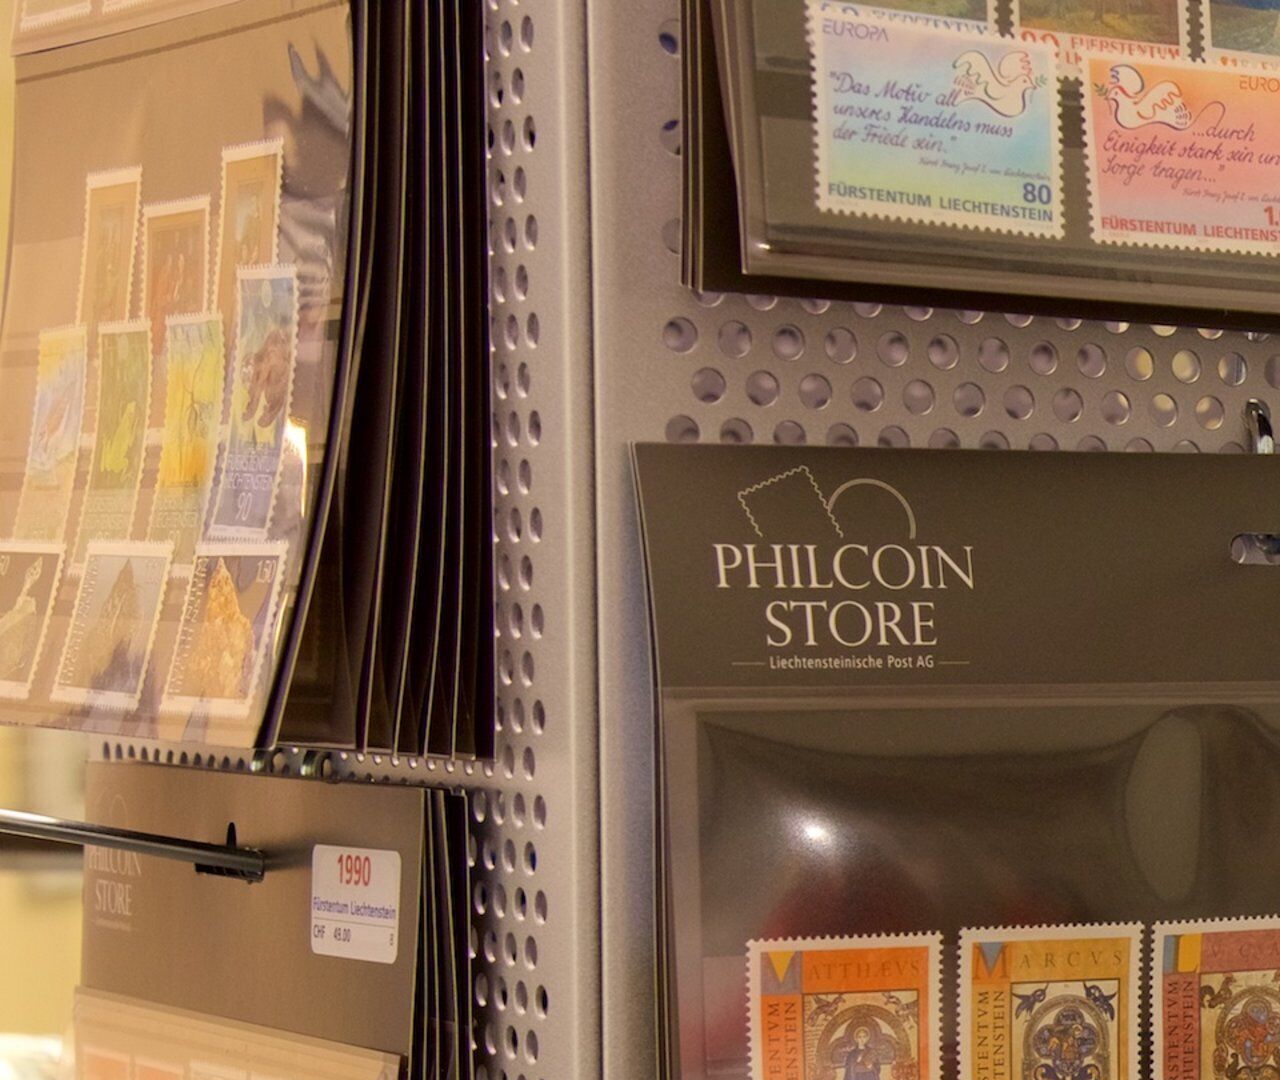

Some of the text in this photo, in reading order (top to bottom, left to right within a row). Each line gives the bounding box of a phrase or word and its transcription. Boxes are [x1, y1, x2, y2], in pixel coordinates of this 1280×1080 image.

[822, 19, 889, 43] EUROPA
[874, 80, 932, 104] Motiv
[935, 89, 959, 108] all
[832, 121, 909, 149] der Friede
[833, 104, 1013, 138] unseres Handelns muss
[1103, 130, 1174, 163] Einigkeit
[1178, 146, 1222, 162] stark
[828, 181, 1053, 222] FÜRSTENTUM LIECHTENSTEIN
[1022, 182, 1052, 205] 80
[1101, 216, 1196, 235] FÜRSTENTUM
[712, 543, 974, 590] PHILCOIN
[765, 600, 938, 647] STORE
[769, 654, 935, 670] Liechtensteinische Post AG
[337, 853, 371, 887] 1990
[95, 879, 132, 916] STORE
